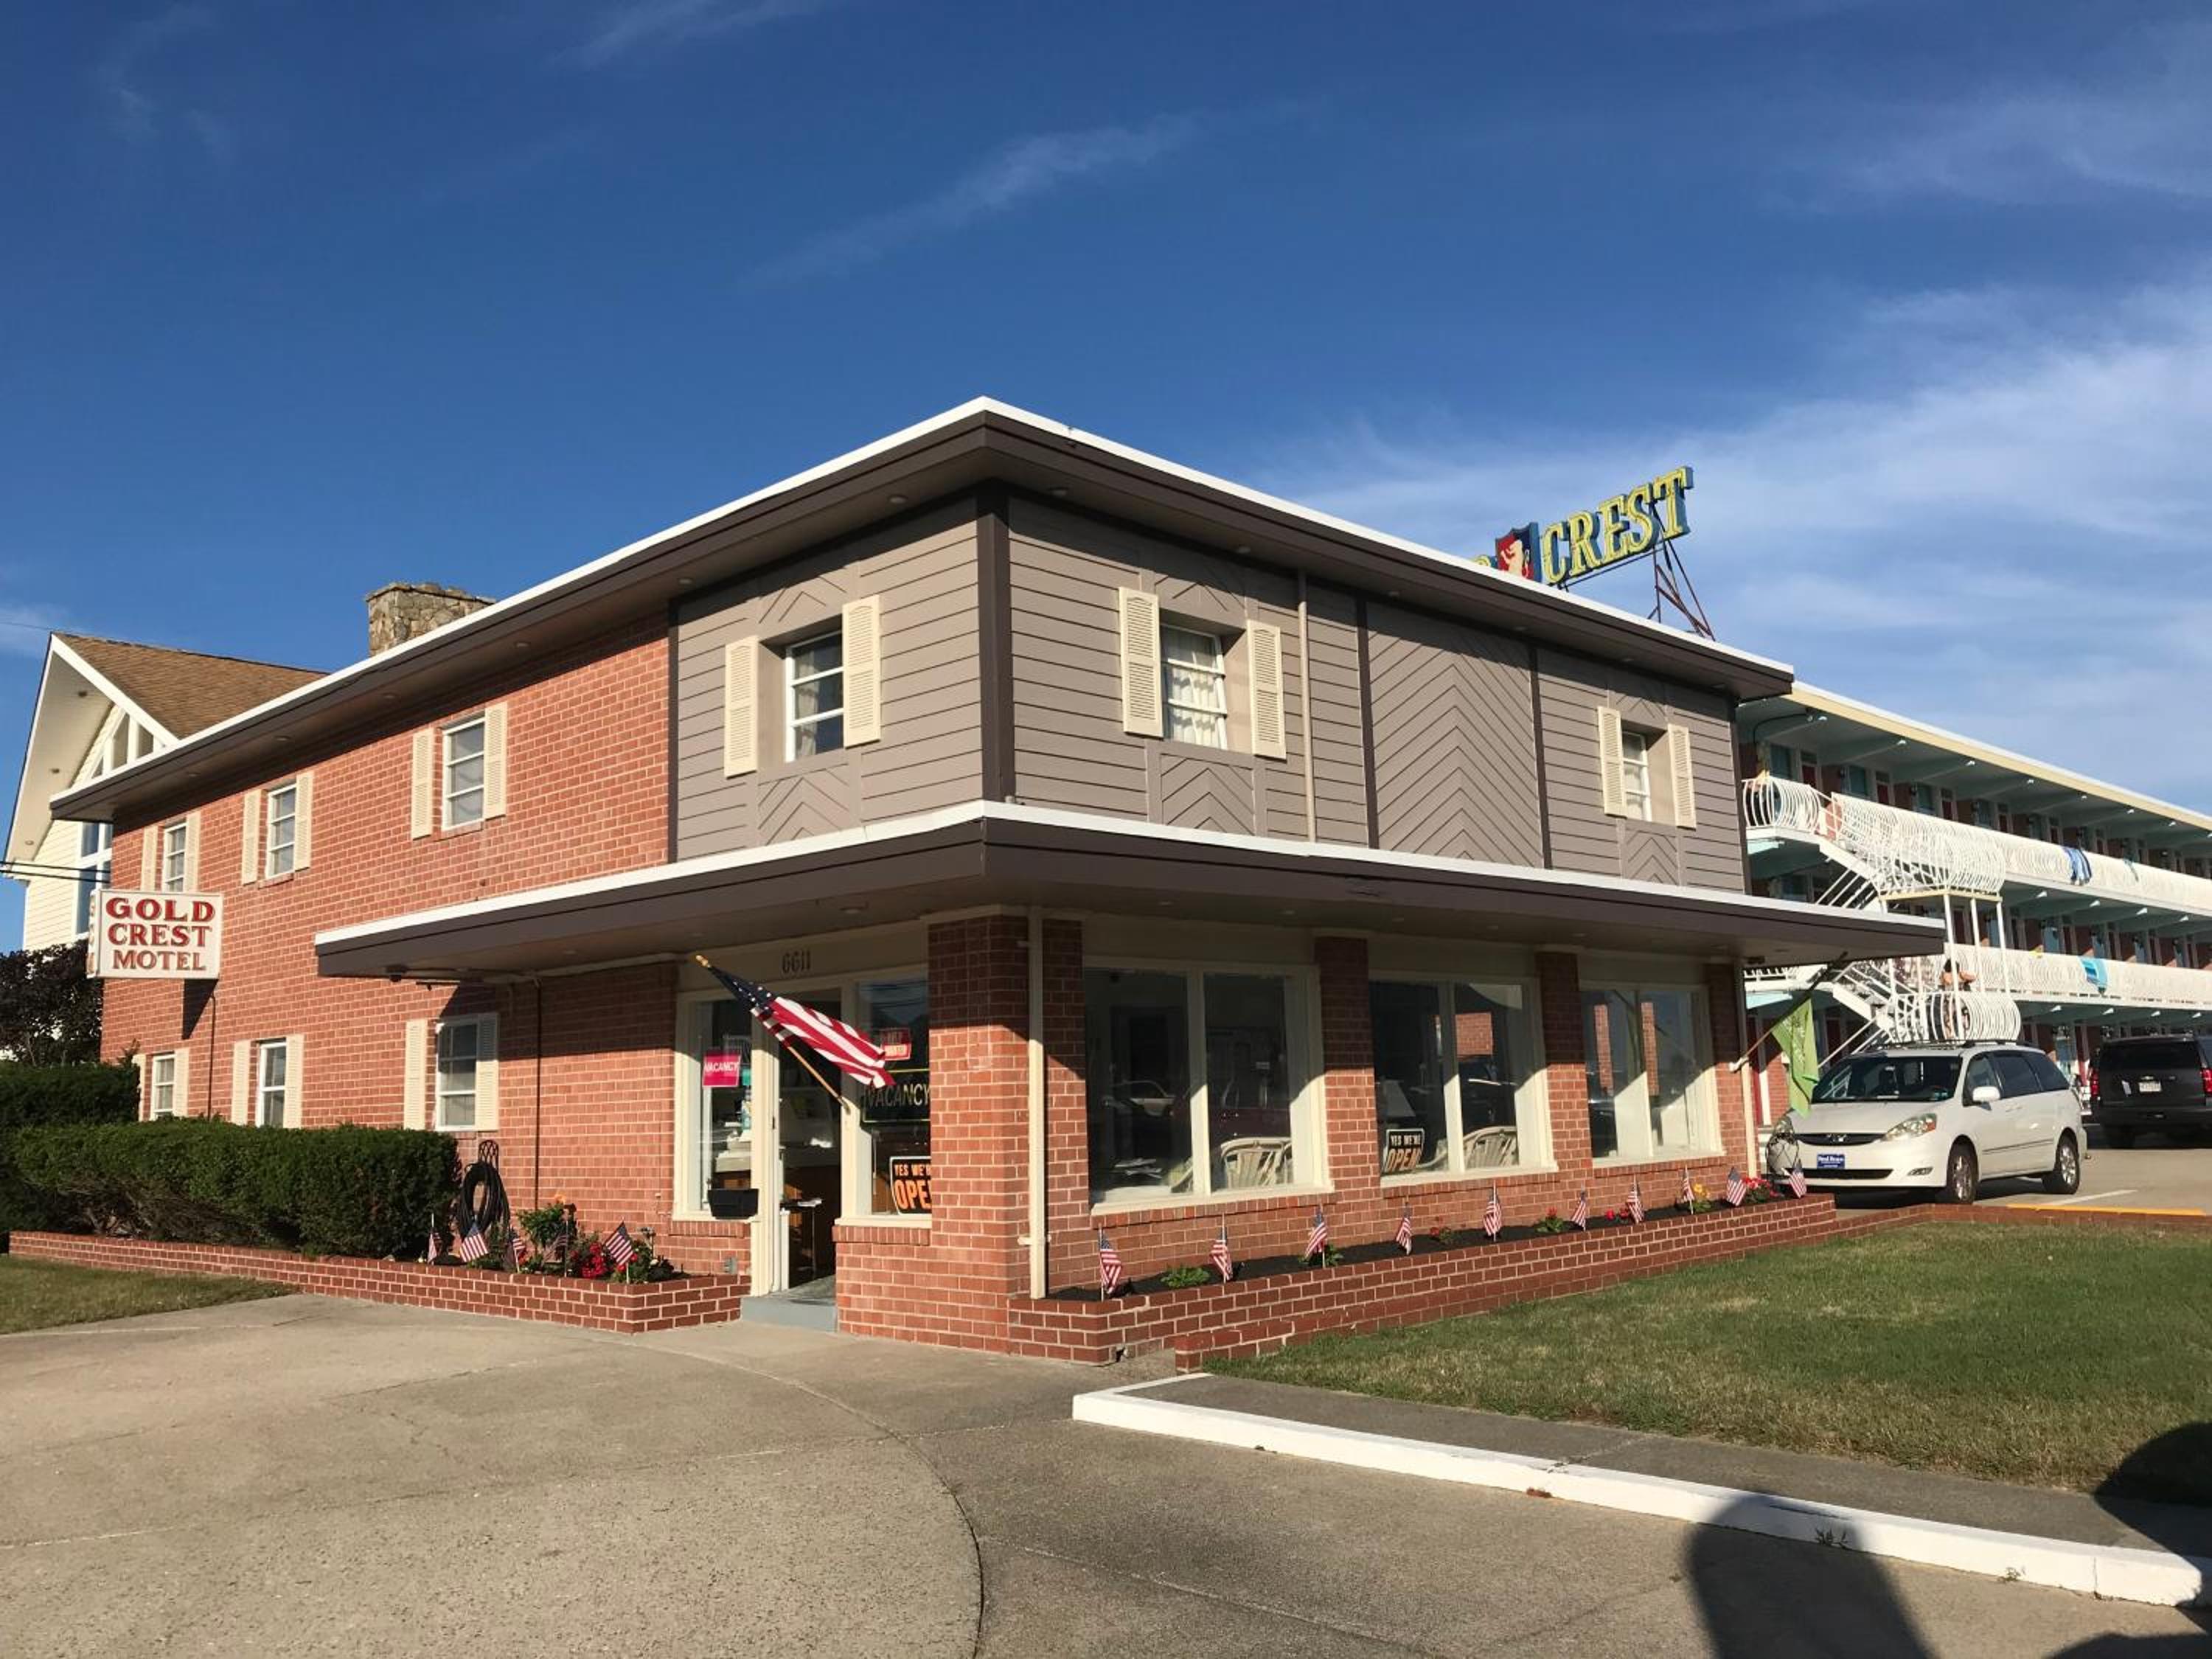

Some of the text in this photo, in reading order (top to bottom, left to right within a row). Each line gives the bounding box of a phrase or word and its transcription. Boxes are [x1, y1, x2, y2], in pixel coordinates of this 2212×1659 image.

[1542, 466, 1694, 585] CREST
[105, 897, 215, 922] GOLD
[108, 923, 212, 947] CREST
[112, 950, 207, 971] MOTEL
[704, 1062, 738, 1073] VACANCY
[894, 1164, 908, 1176] YES
[1385, 1148, 1422, 1172] OPEN
